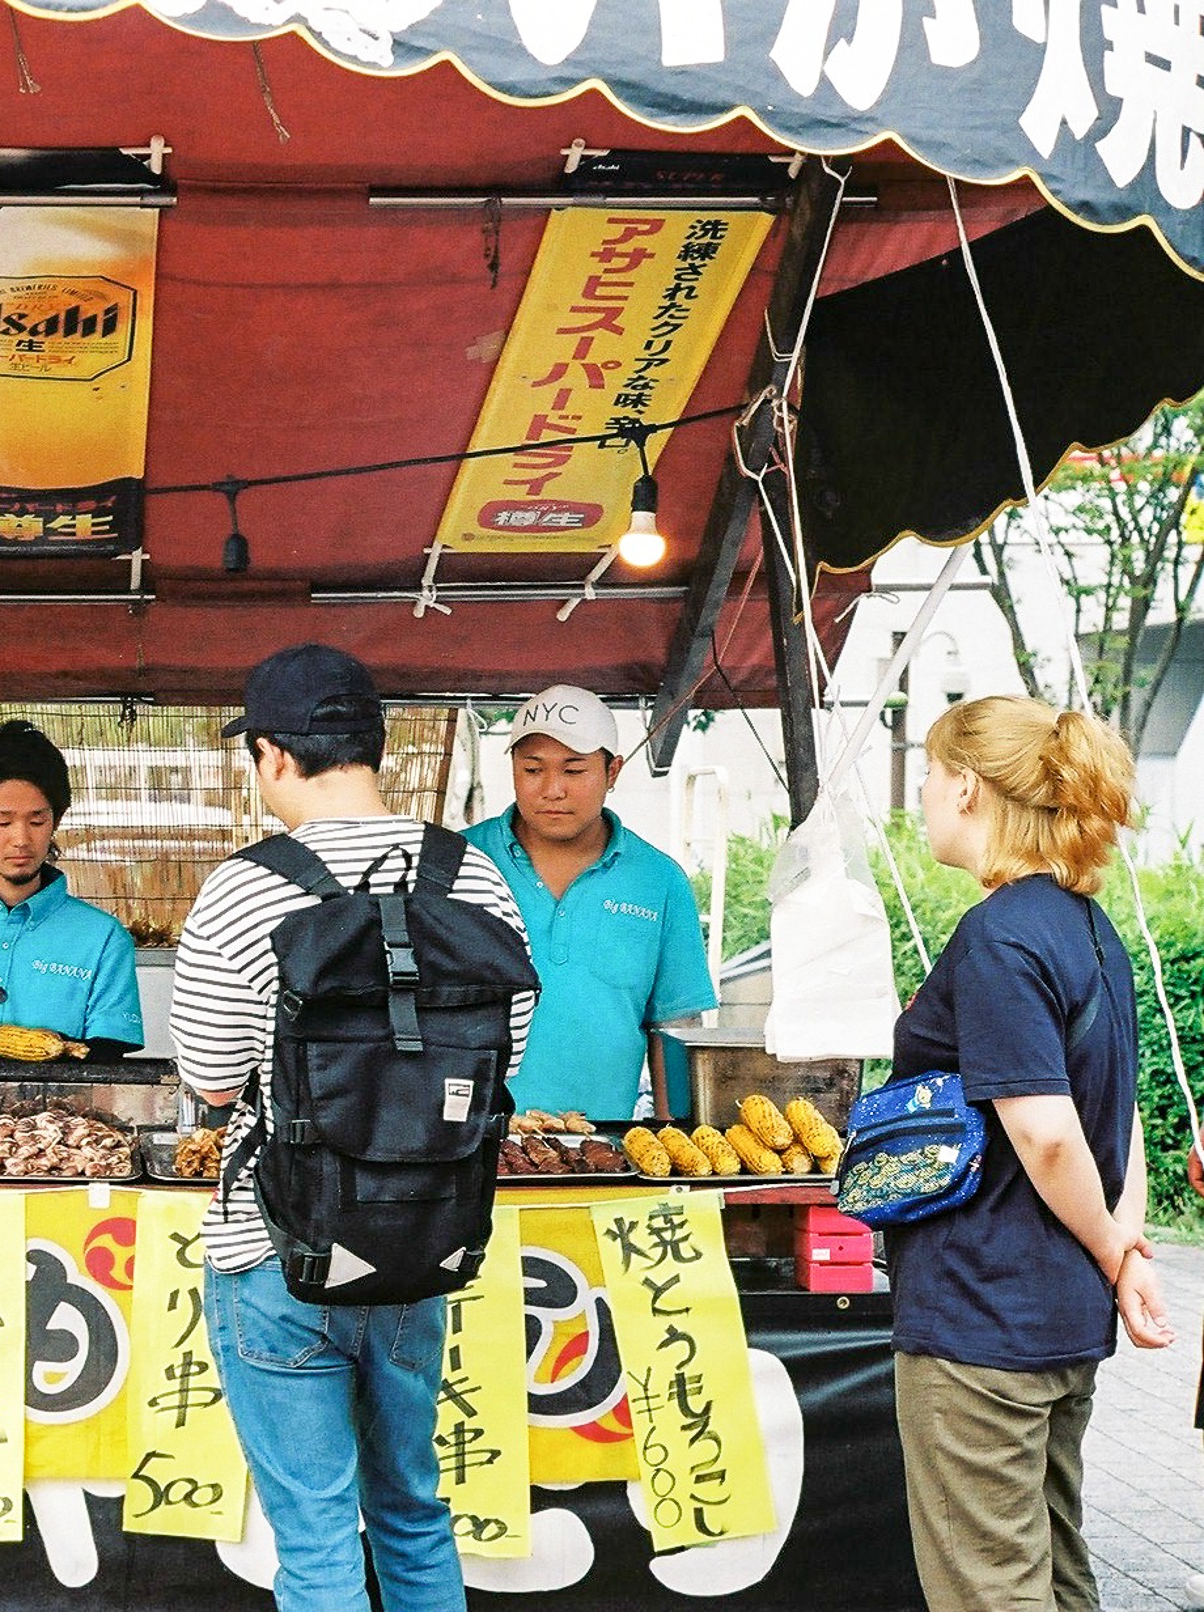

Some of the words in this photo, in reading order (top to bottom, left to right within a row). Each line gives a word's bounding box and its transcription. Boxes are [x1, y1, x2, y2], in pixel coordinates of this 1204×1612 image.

[14, 338, 46, 353] 生
[502, 216, 667, 497] アサヒスーパードライ
[521, 701, 581, 727] NYC
[147, 1230, 224, 1430] とり串
[602, 1202, 732, 1538] 焼とうもろこし
[626, 1366, 684, 1530] ¥600
